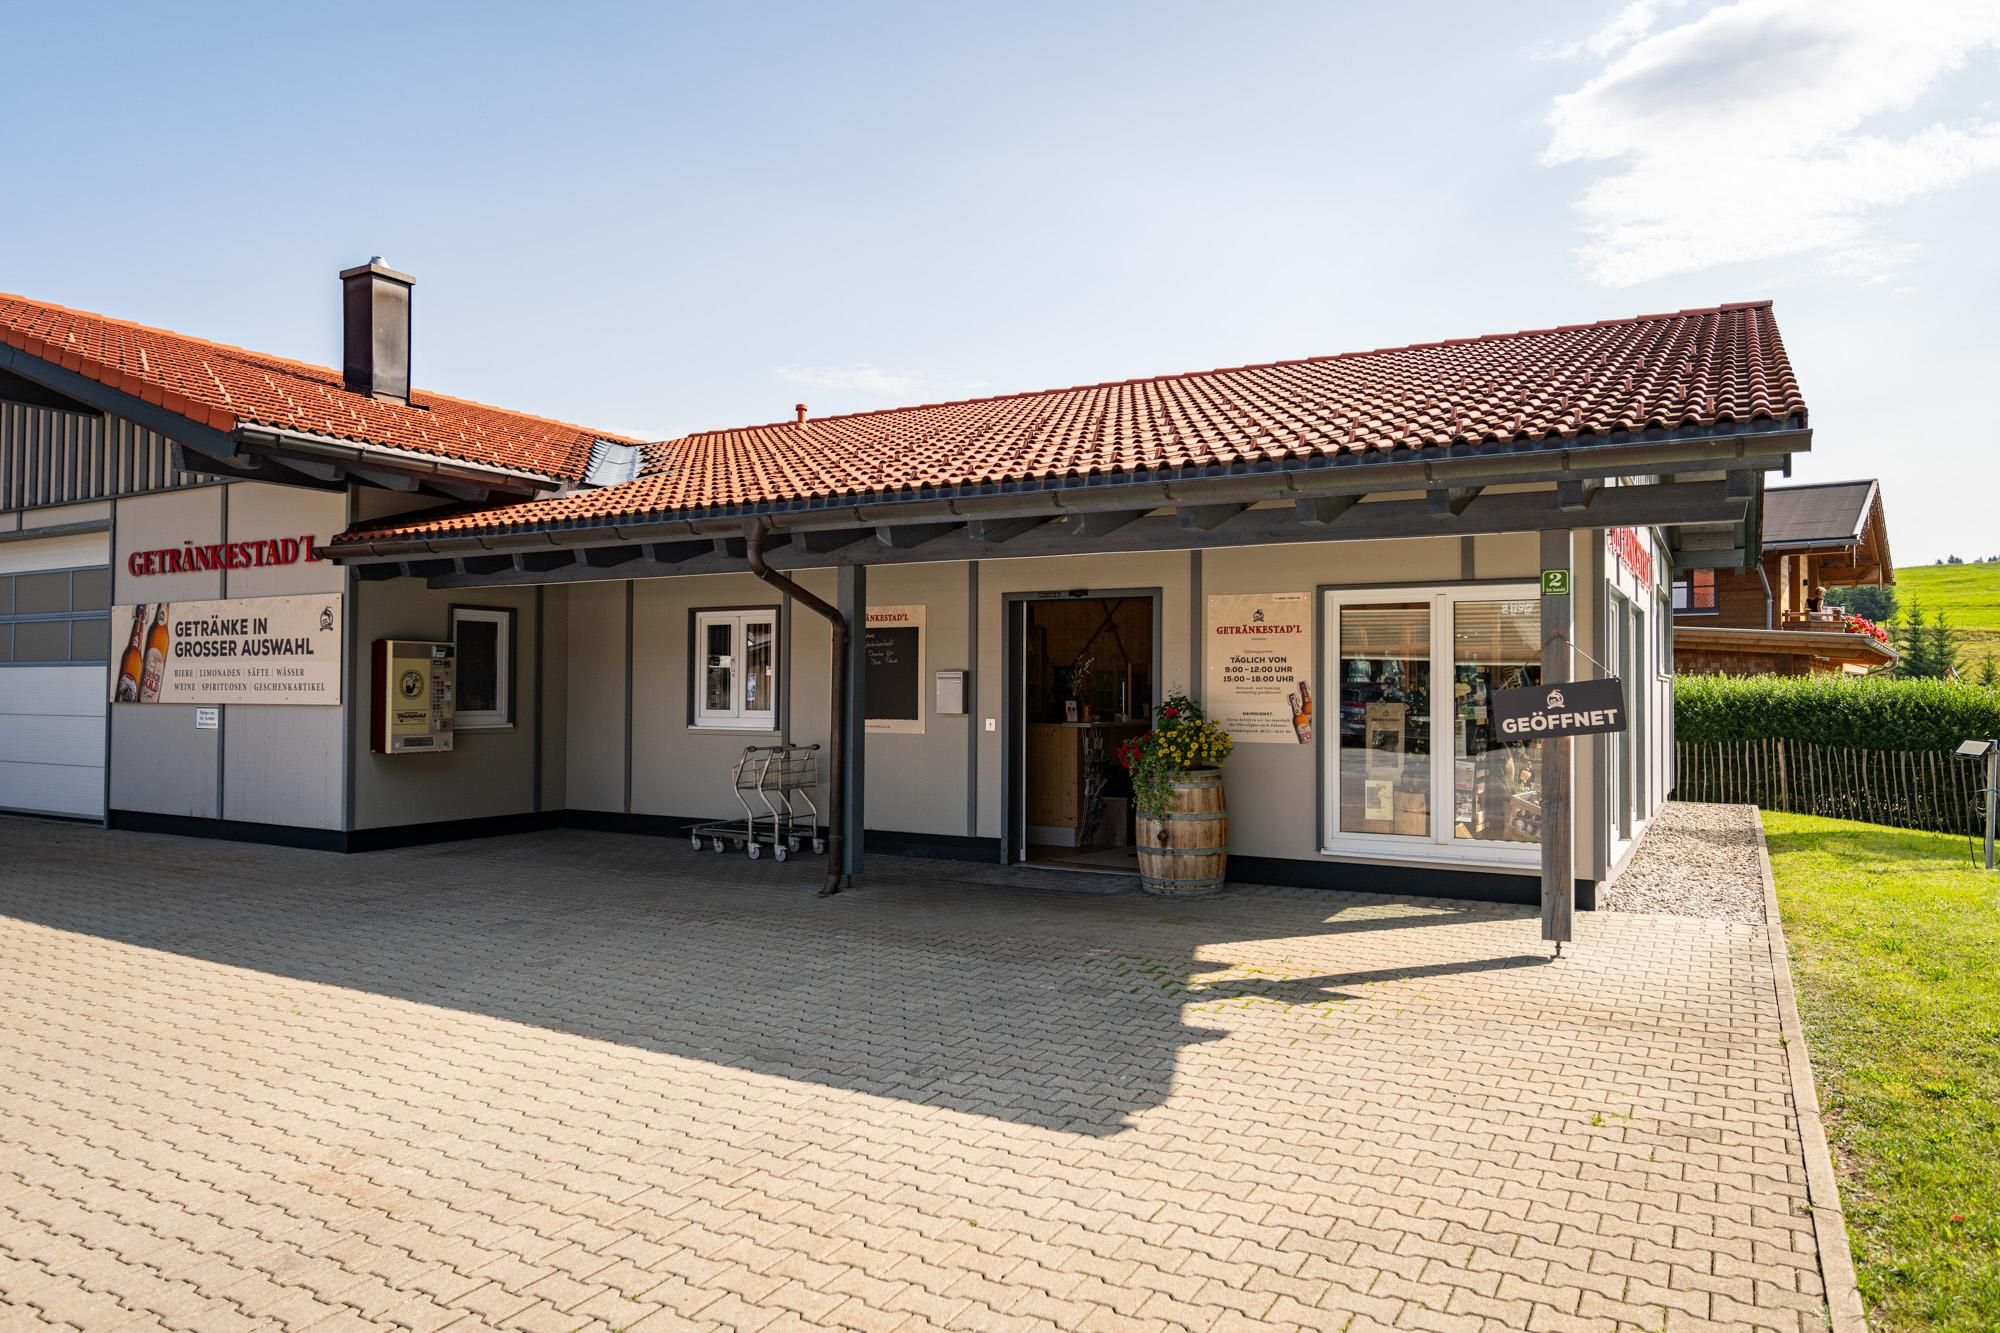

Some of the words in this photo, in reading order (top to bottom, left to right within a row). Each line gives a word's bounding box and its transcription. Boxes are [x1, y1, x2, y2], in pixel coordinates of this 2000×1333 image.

[128, 535, 322, 577] GETRÄNKESTAD'L
[1549, 573, 1562, 587] 2
[865, 613, 909, 622] ÄNKESTAD'L
[175, 615, 248, 637] GETRÄNKE
[253, 618, 268, 635] IN
[1216, 624, 1302, 635] GETRÄNKESTAD'L
[175, 640, 237, 658] GROSSER
[241, 638, 314, 656] AUSWAHL
[1230, 655, 1265, 664] TÄGLICH
[174, 669, 194, 678] BIERE
[199, 668, 241, 677] LIMONADEN
[247, 667, 270, 677] SÄFTE
[276, 667, 305, 677] WÄSSER
[174, 682, 196, 691] WEINE
[201, 682, 247, 691] SPIRITUOSEN
[253, 682, 325, 691] GESCHENKARTIKEL
[1502, 709, 1618, 734] GEÖFFNET
